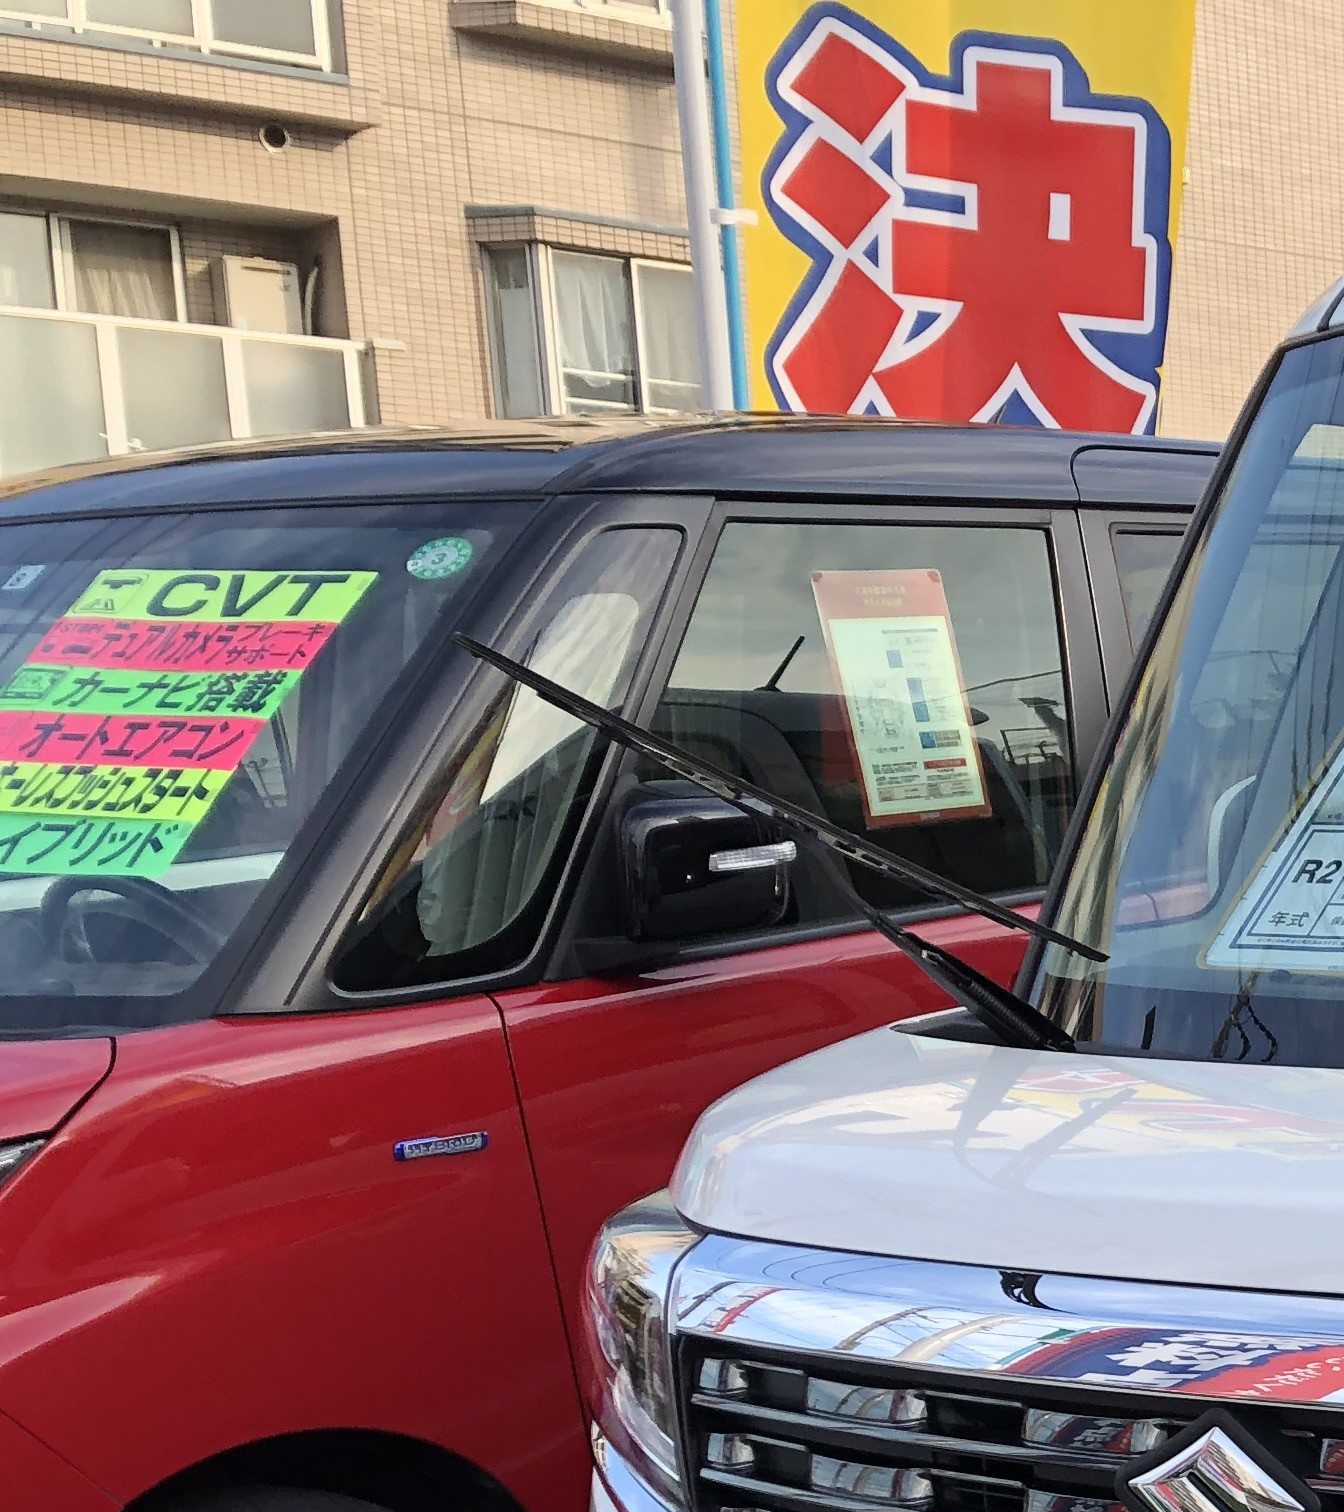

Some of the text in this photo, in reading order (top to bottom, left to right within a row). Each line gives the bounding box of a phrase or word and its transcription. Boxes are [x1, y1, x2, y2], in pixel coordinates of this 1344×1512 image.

[772, 18, 1162, 433] 決
[146, 573, 352, 617] CVT
[52, 670, 288, 712] カーナビ搭載
[19, 713, 245, 762] オートエアコン
[1291, 858, 1343, 884] R2
